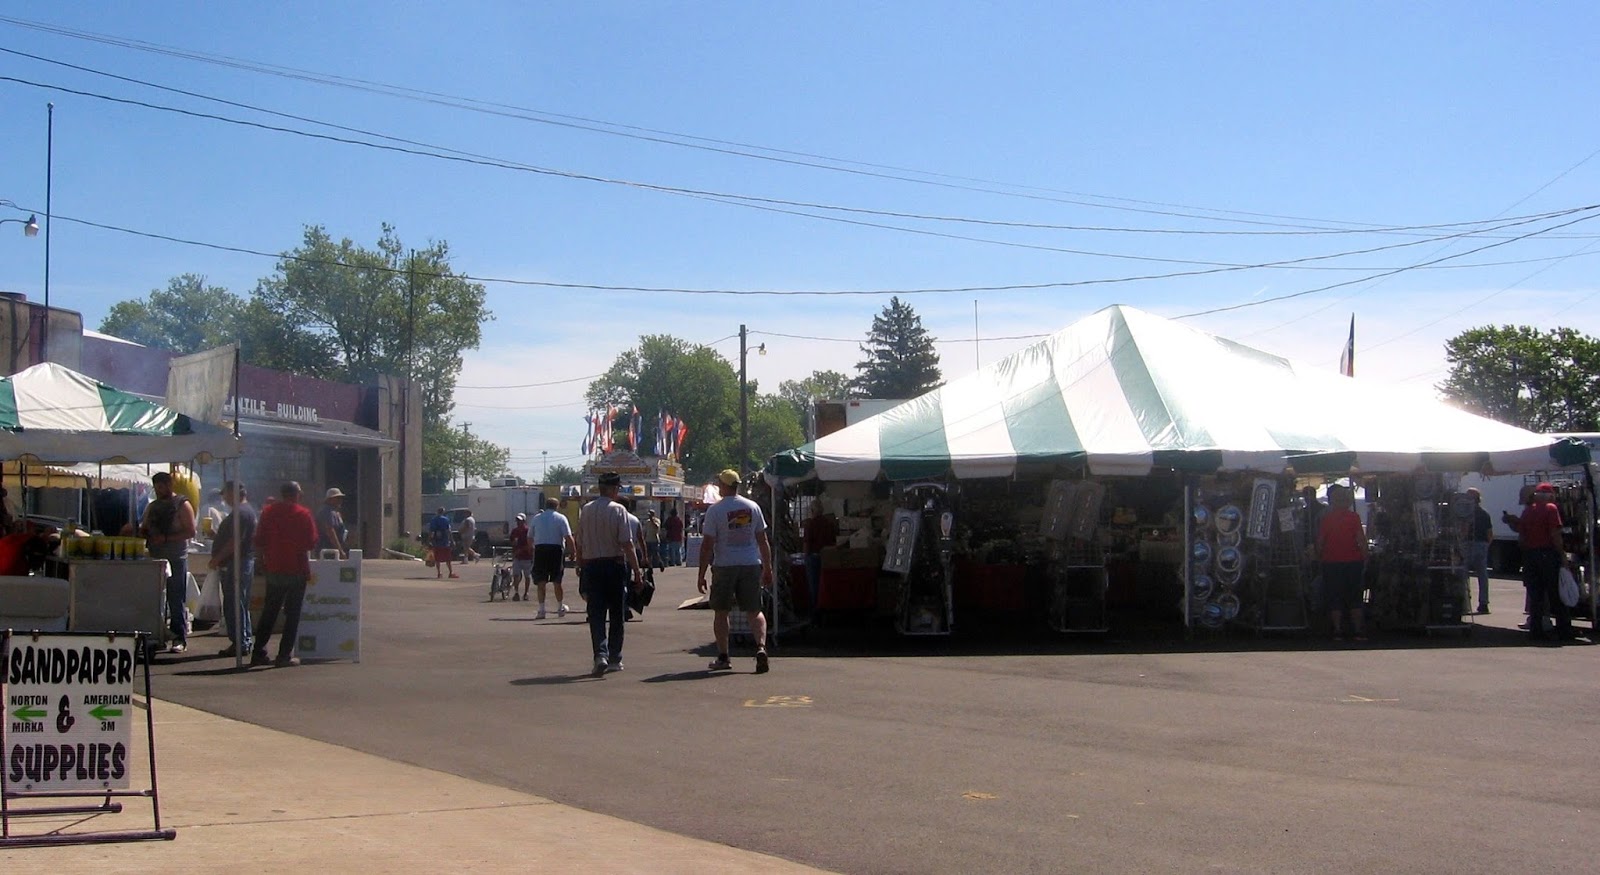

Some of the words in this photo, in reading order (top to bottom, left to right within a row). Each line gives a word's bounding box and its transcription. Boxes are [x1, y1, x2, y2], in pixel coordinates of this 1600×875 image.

[223, 396, 266, 416] ANTILE
[277, 402, 318, 422] BUILDING
[9, 646, 132, 685] SANDPAPER
[11, 695, 48, 706] NORTON
[83, 694, 130, 705] AMERICAN
[56, 694, 75, 734] &
[12, 721, 44, 733] MIRKA
[100, 721, 115, 731] 3M
[9, 742, 126, 783] SUPPLIES
